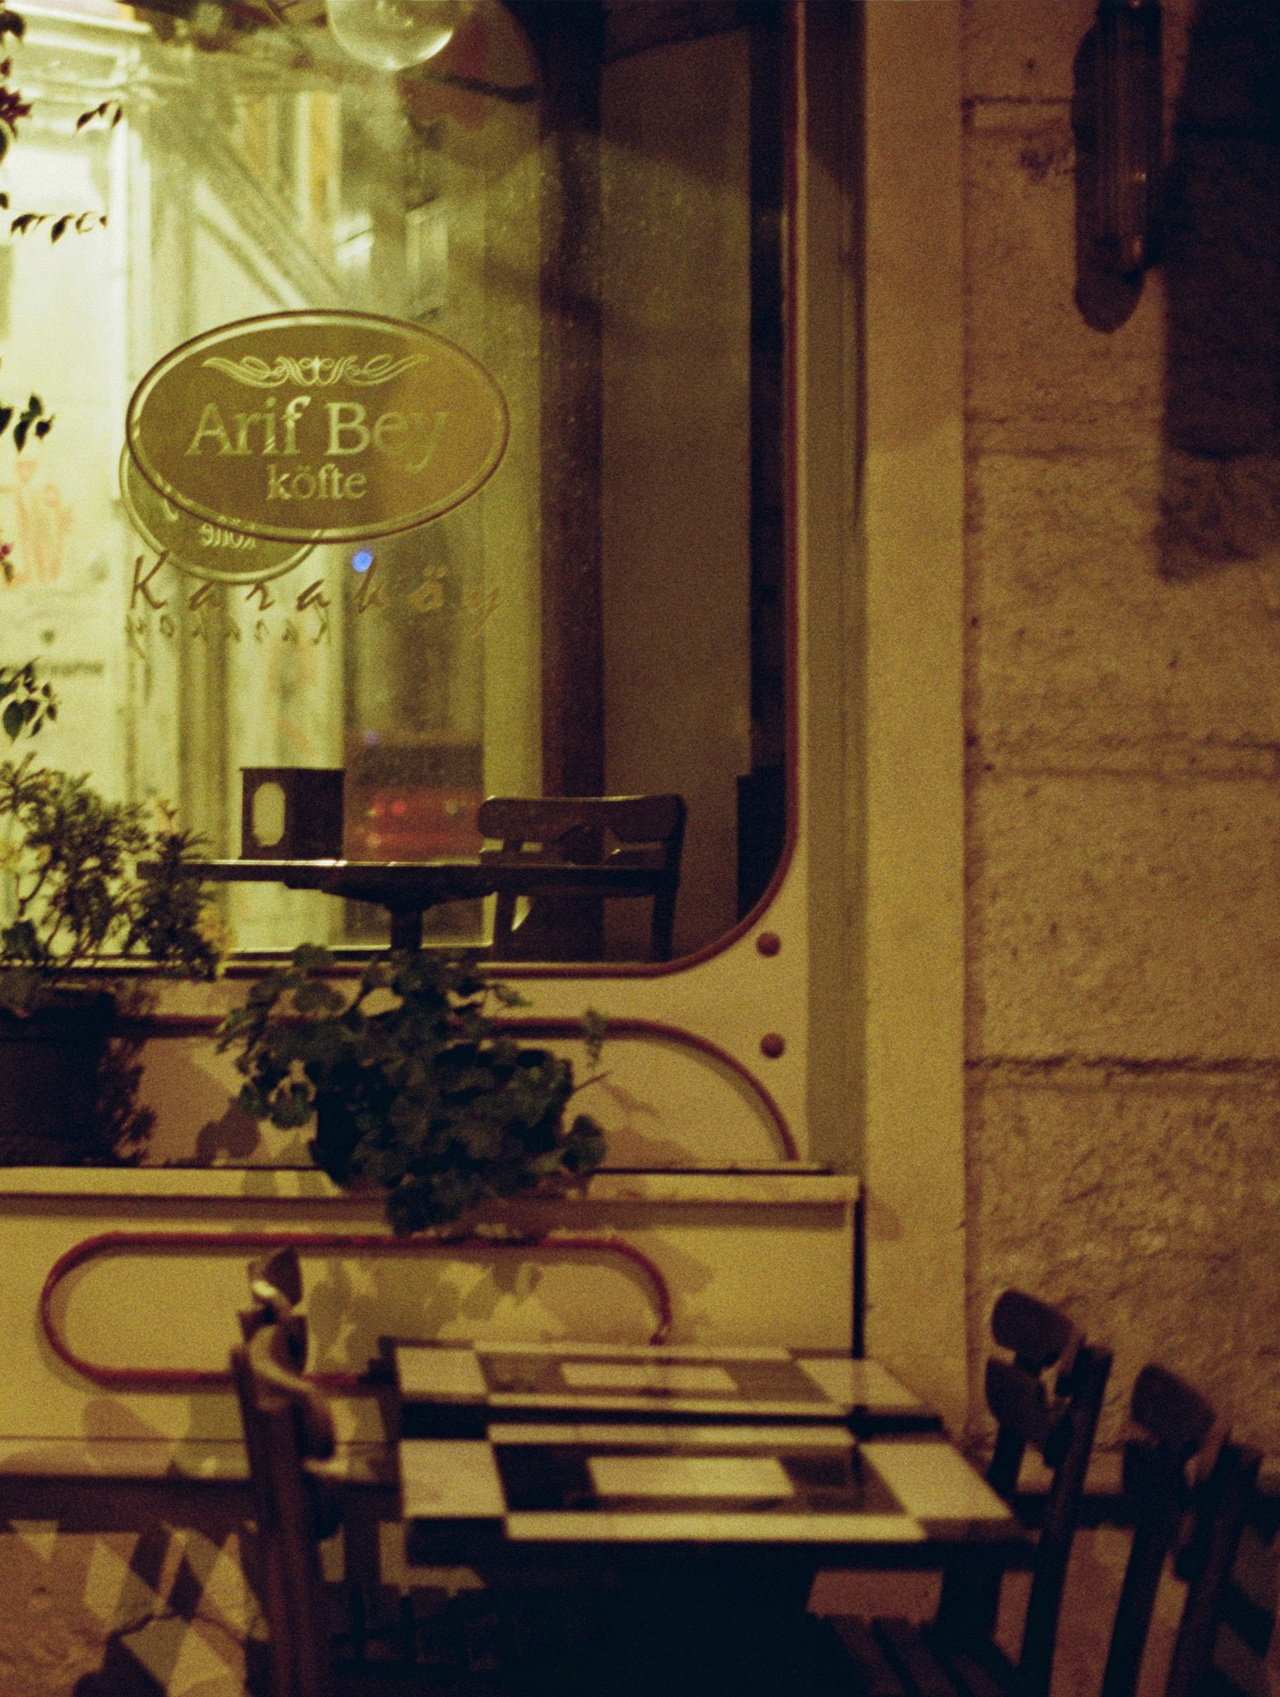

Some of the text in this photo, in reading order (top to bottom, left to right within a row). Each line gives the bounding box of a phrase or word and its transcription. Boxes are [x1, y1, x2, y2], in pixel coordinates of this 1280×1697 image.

[184, 396, 449, 474] Arif Bey
[266, 464, 368, 500] köfte
[131, 551, 506, 638] Karaköy
